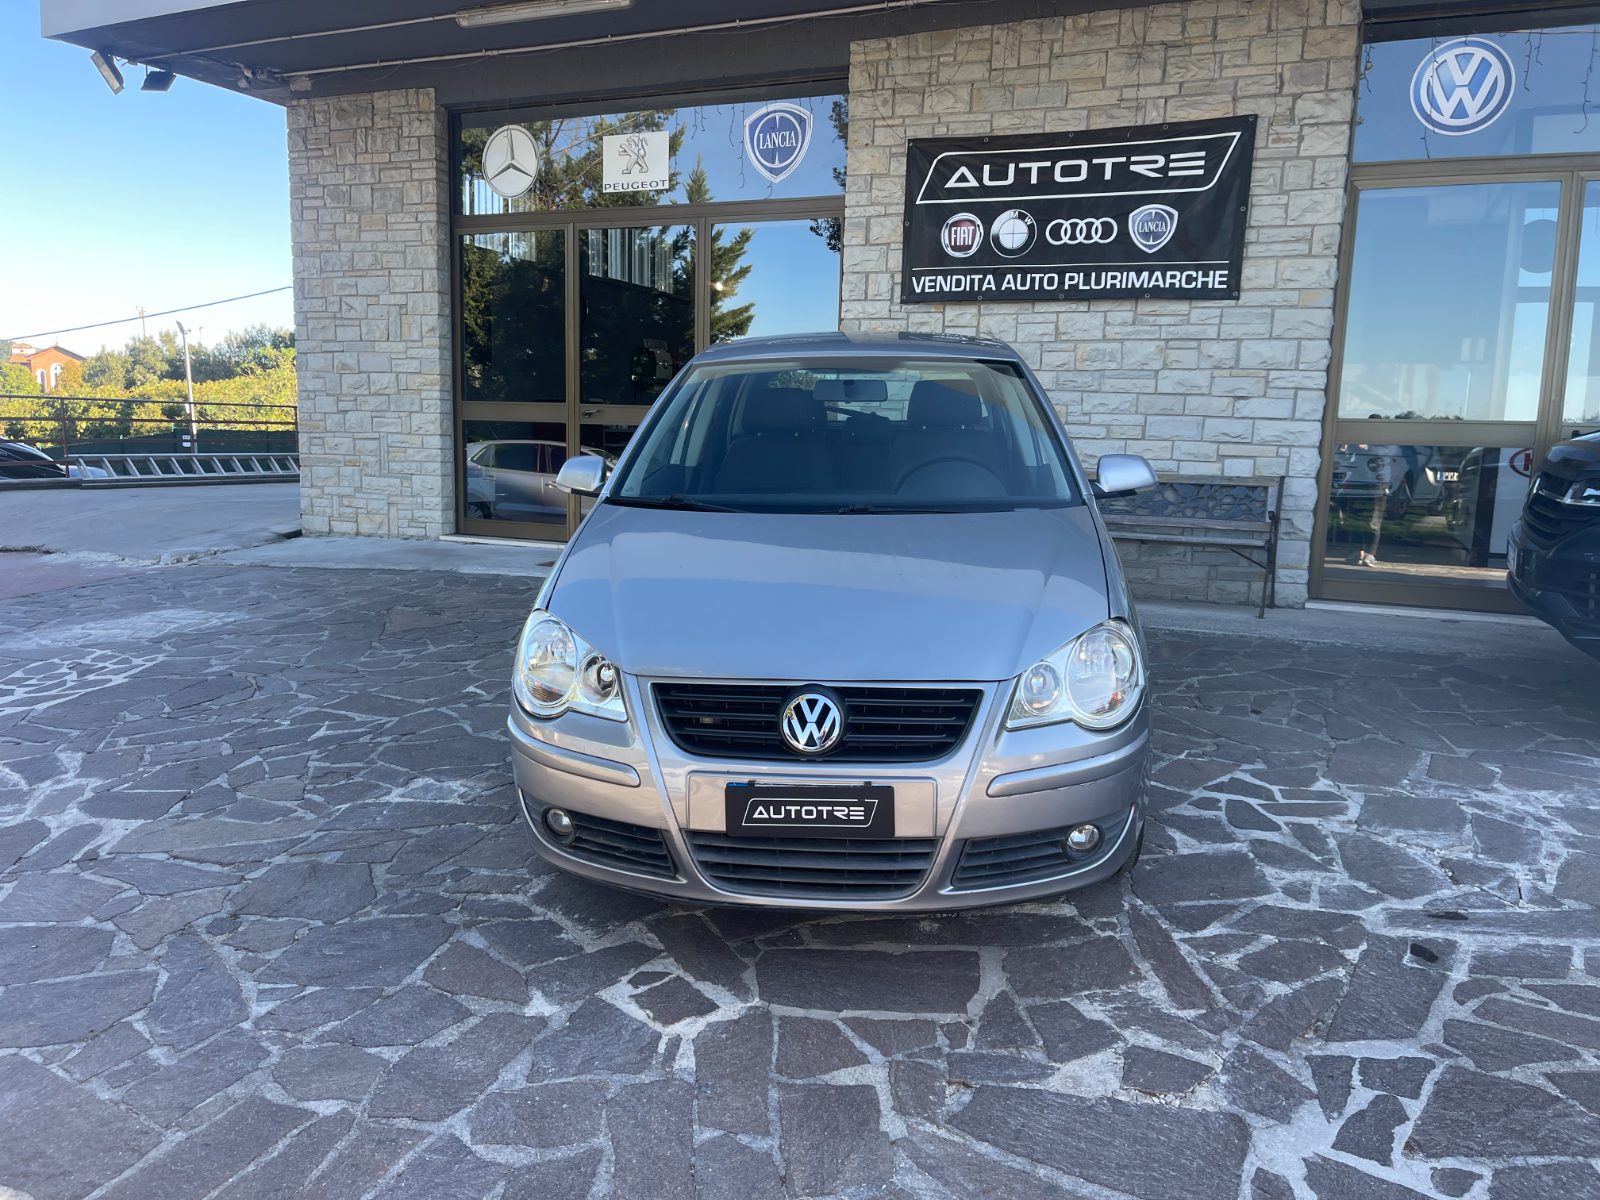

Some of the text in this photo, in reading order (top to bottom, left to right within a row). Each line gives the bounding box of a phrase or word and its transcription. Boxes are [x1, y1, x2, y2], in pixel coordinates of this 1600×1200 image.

[758, 131, 797, 149] LANCIA
[944, 151, 1206, 188] AUTOTRE
[604, 179, 668, 191] PEUGEOT
[951, 226, 975, 246] FIAT
[1139, 221, 1167, 234] LANCIA
[912, 270, 1230, 294] VENDITA AUTO PLURIMARCHE
[752, 805, 865, 820] AUTOTRE
